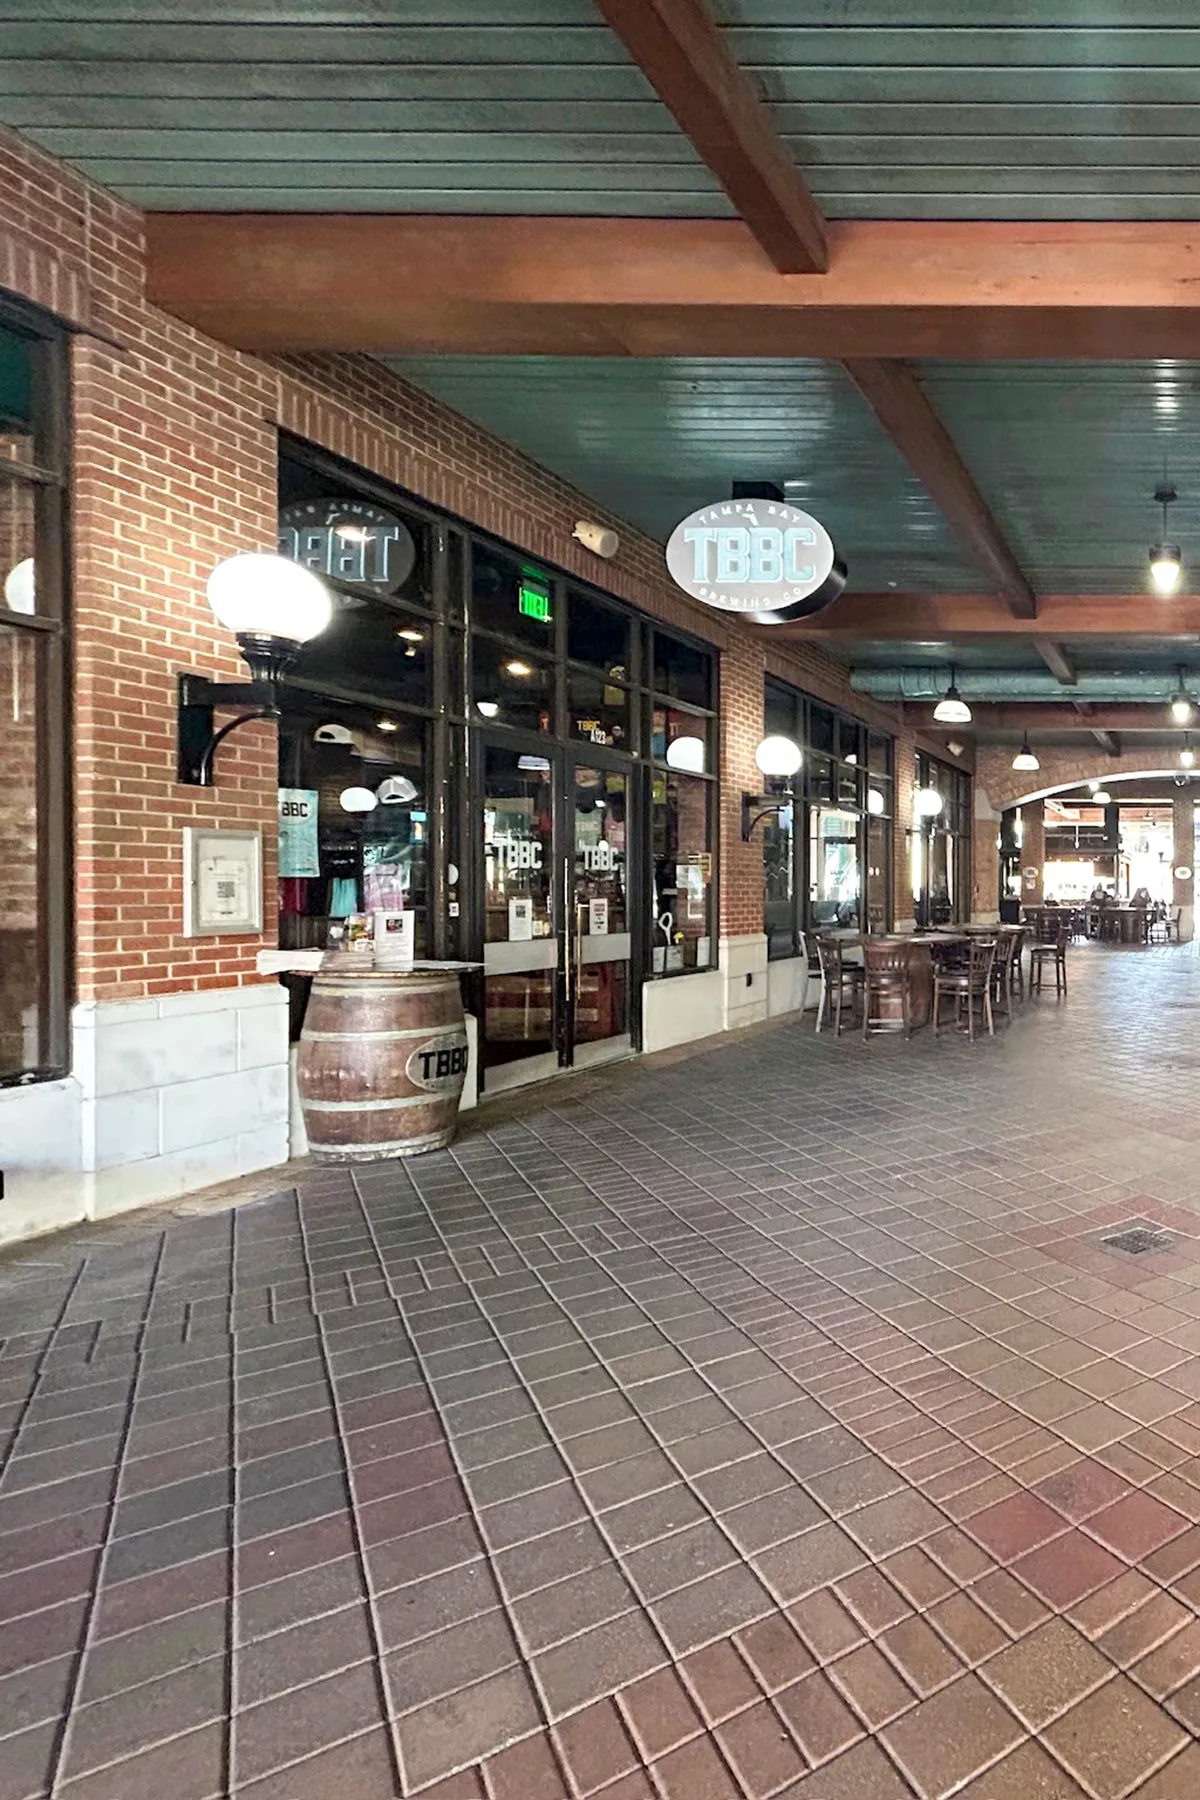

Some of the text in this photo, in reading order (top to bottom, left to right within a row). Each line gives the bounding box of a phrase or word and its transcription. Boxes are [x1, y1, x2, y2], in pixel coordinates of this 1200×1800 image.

[699, 503, 800, 525] TAMPA BAY
[683, 527, 816, 584] TBBC
[699, 587, 771, 607] BREWING
[278, 801, 309, 818] BBC
[493, 839, 543, 870] TBBC
[584, 844, 619, 871] TBBC
